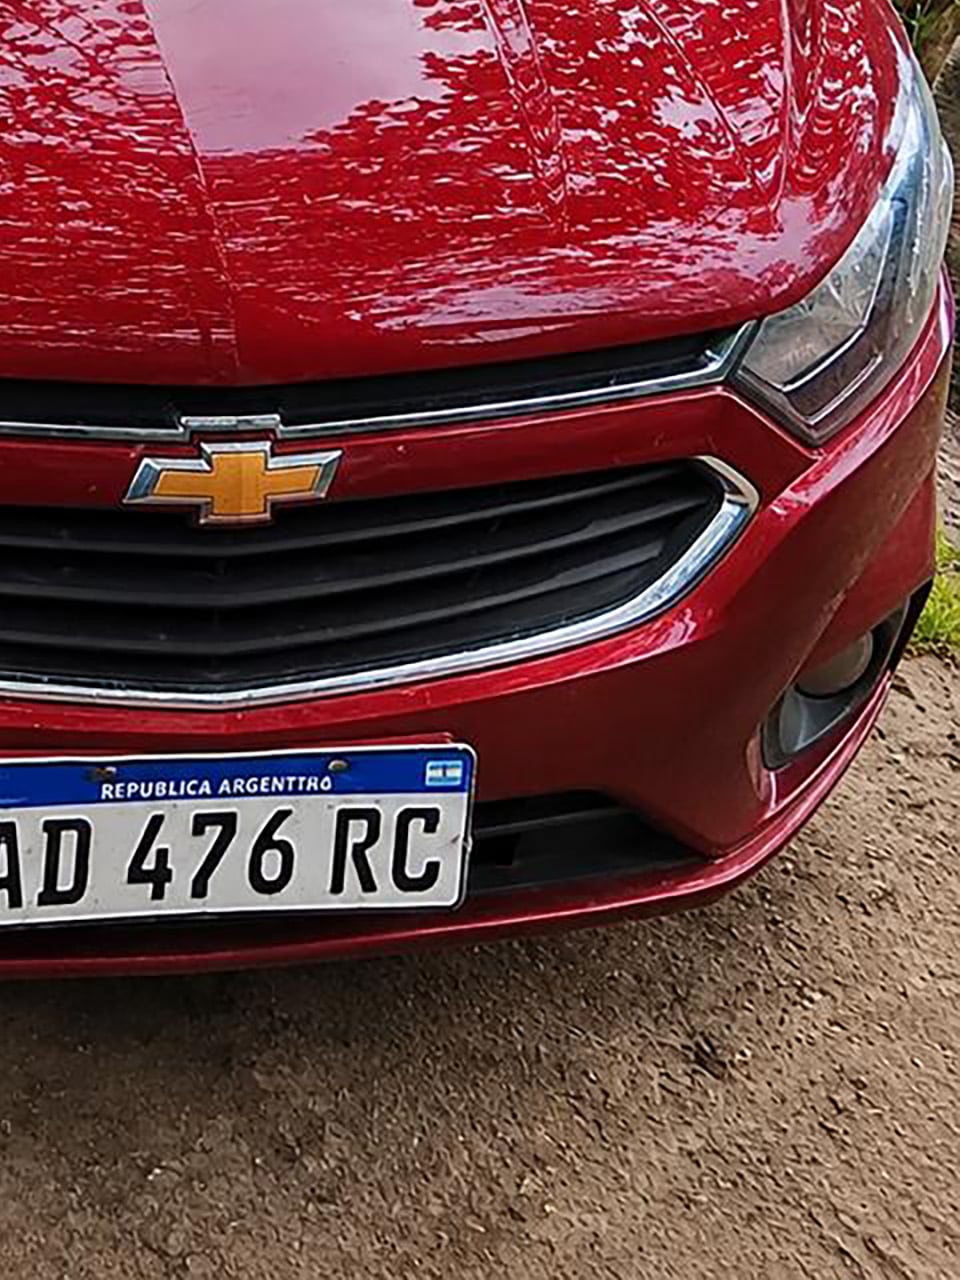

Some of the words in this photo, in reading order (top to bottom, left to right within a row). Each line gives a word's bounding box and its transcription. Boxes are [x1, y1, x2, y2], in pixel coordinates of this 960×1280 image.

[100, 779, 212, 800] REPUBLICA
[126, 808, 296, 901] 476
[328, 806, 441, 896] RC
